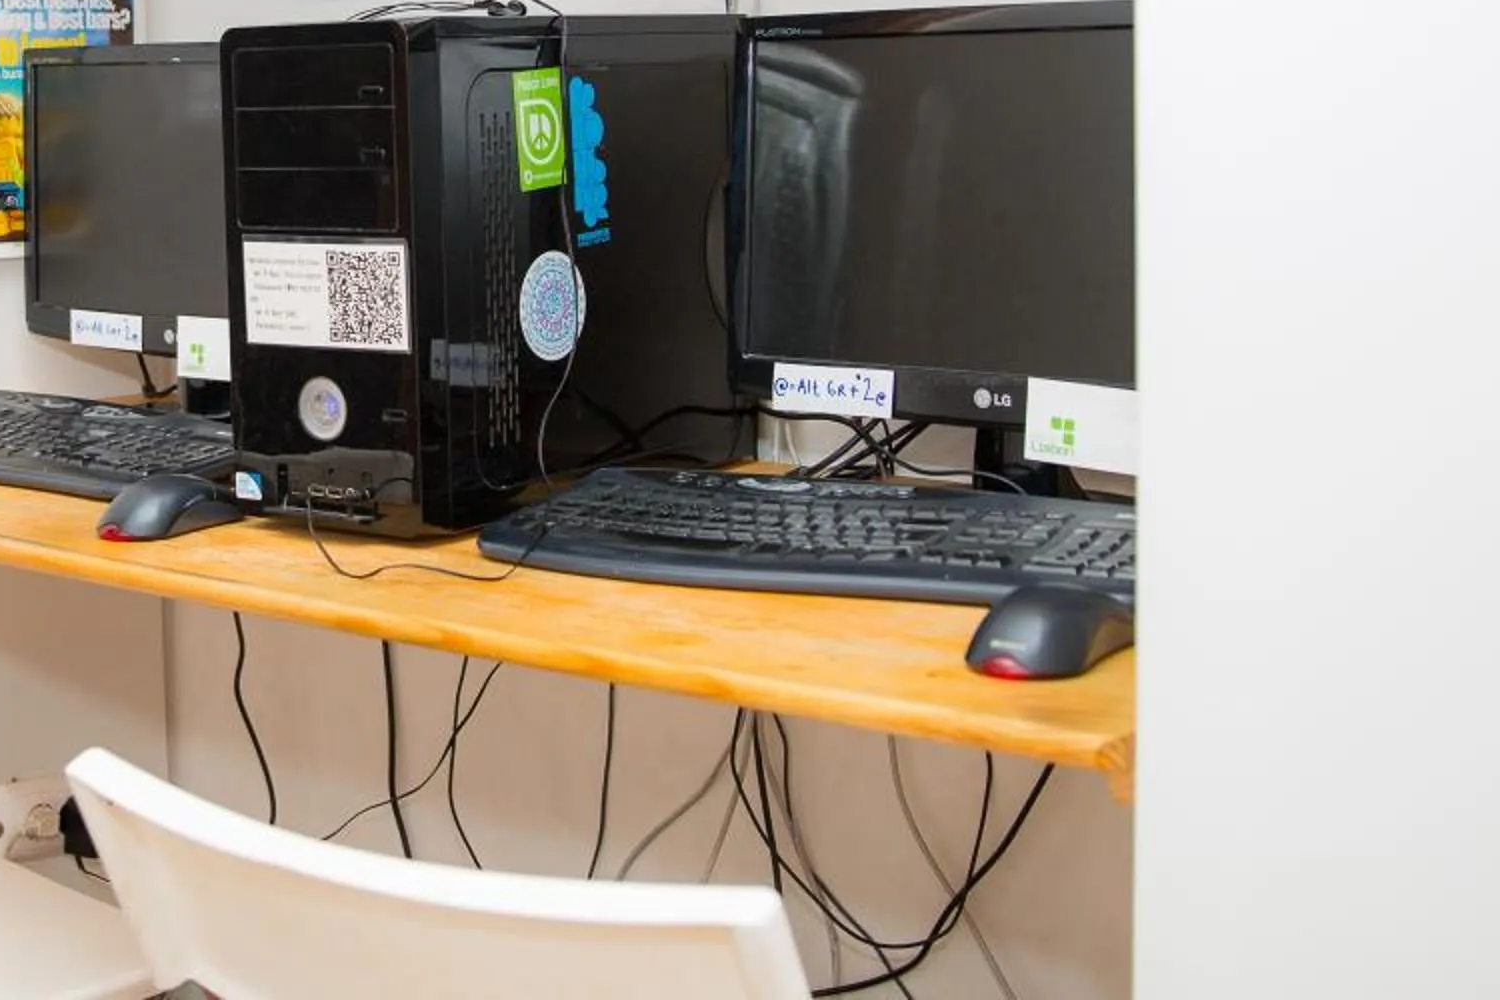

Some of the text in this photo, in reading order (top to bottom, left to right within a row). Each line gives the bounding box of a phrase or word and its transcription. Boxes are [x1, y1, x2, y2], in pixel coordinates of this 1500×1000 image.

[50, 9, 85, 29] best
[87, 8, 131, 30] bars?
[994, 394, 1012, 408] LG
[1030, 439, 1075, 458] Lisbon
